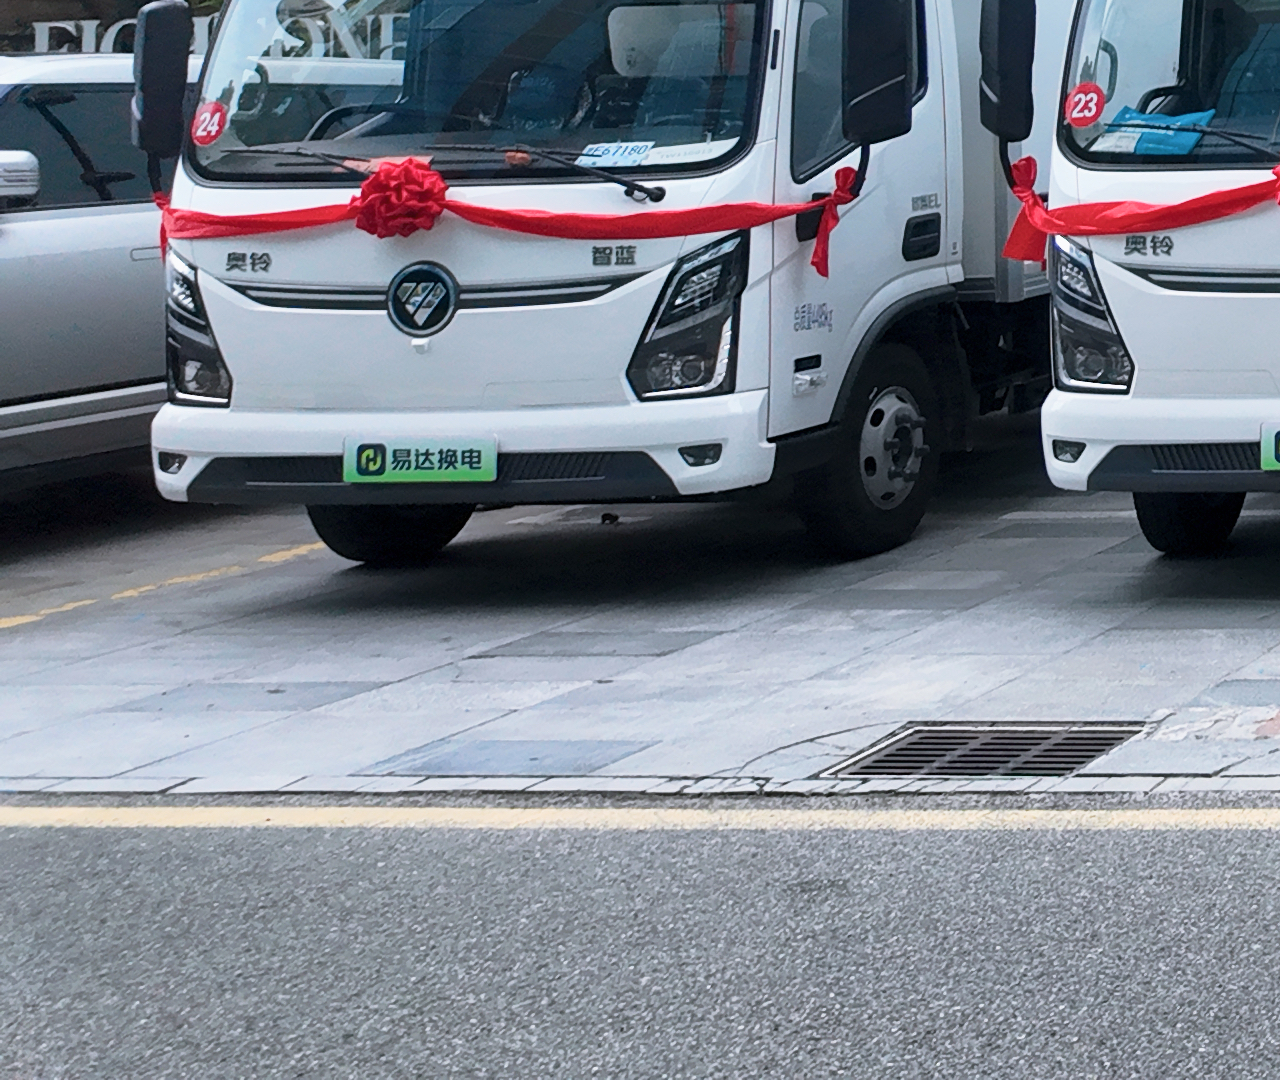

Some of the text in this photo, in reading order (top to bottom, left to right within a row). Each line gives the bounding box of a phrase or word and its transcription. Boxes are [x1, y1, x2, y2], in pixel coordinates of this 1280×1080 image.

[1071, 92, 1098, 118] 23
[197, 113, 220, 136] 24
[591, 245, 637, 267] 智蓝
[1124, 236, 1174, 259] 奥铃
[225, 251, 273, 273] 奥铃
[391, 448, 482, 471] 易达换电
